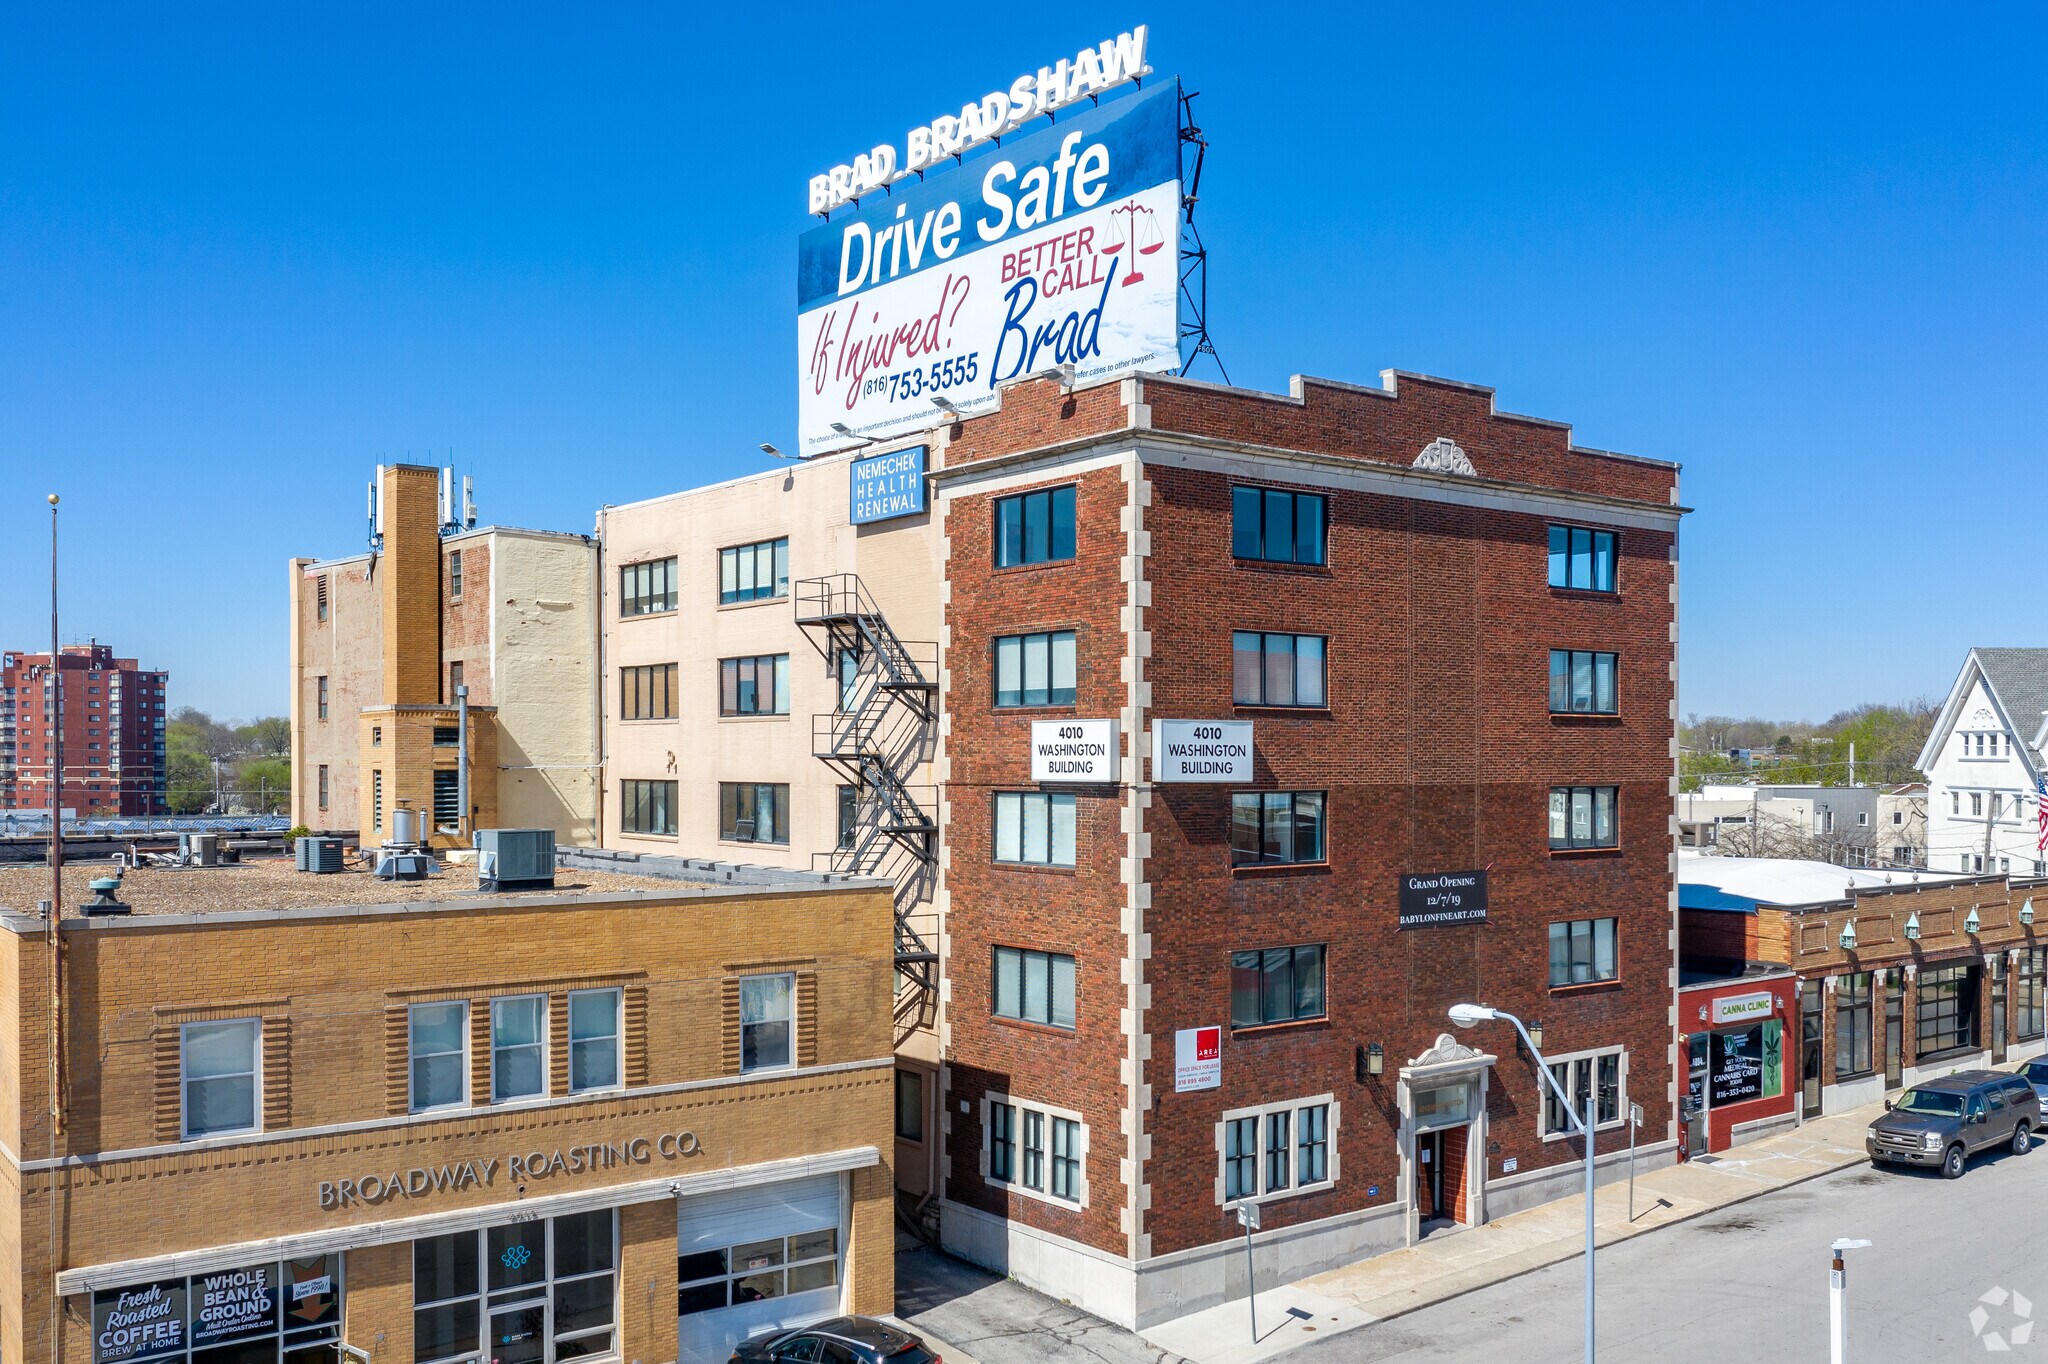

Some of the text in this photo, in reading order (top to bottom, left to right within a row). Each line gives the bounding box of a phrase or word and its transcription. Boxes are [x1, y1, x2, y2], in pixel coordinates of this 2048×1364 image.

[808, 24, 1149, 215] BRAD BRADSHAW
[837, 130, 1110, 297] Drive Safe
[1001, 226, 1095, 284] BETTER
[1042, 254, 1105, 298] CALL
[989, 256, 1119, 391] Brad
[810, 273, 971, 411] If Injured?
[863, 352, 979, 404] (816) 753-5555
[1089, 366, 1107, 376] cases
[1107, 364, 1114, 372] to
[1114, 359, 1131, 369] other
[957, 400, 972, 410] solely
[972, 397, 986, 405] upon
[862, 421, 884, 433] important
[883, 417, 902, 427] decision
[902, 413, 911, 422] and
[911, 409, 928, 420] should
[928, 408, 936, 417] not
[857, 453, 916, 481] NEMECHEK
[857, 472, 917, 500] HEALTH
[857, 493, 916, 519] RENEWAL
[1058, 726, 1083, 739] 4010
[1193, 727, 1222, 740] 4010
[1038, 743, 1105, 757] WASHINGTON
[1168, 743, 1247, 757] WASHINGTON
[1048, 761, 1093, 774] BUILDING
[1181, 761, 1233, 774] BUILDING
[1426, 892, 1461, 907] 12/7/19
[1400, 909, 1486, 924] BABYLONFINEART.COM
[1722, 1000, 1770, 1016] CANNA CLINIC
[1198, 1048, 1218, 1057] AREA
[1713, 1067, 1759, 1083] CANNABIS CARD
[318, 1131, 702, 1206] BROADWAY ROASTING CO.
[204, 1269, 266, 1291] WHOLE
[117, 1284, 162, 1312] Fresh
[204, 1281, 268, 1307] BEAN &
[106, 1297, 172, 1331] Roasted
[200, 1298, 272, 1322] GROUND
[98, 1319, 181, 1349] COFFEE
[195, 1319, 274, 1339] BROADWAYROASTING.COM
[101, 1336, 180, 1358] BREW AT HOME
